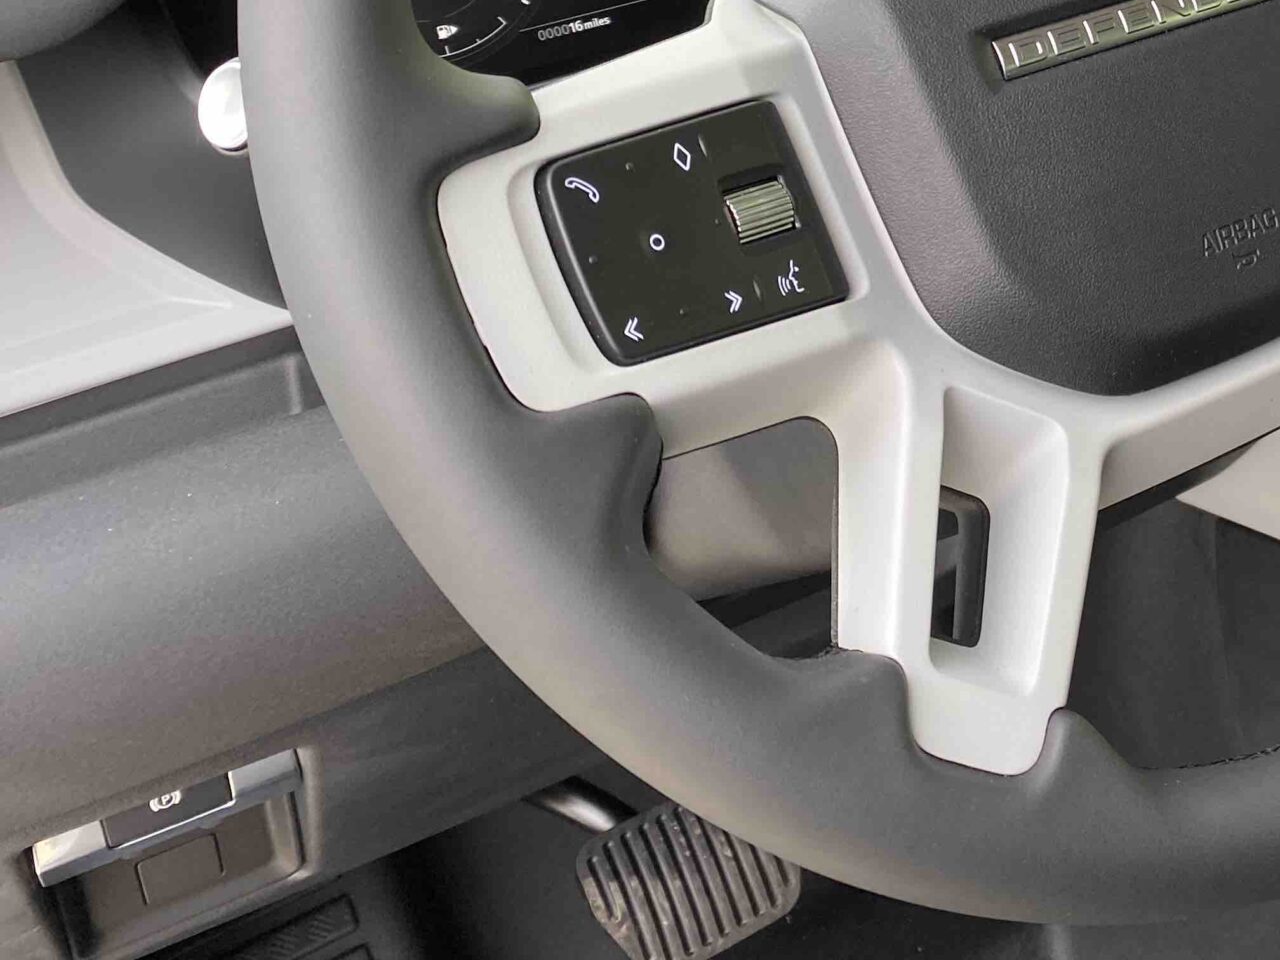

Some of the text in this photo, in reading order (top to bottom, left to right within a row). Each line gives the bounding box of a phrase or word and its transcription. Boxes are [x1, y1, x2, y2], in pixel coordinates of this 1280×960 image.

[537, 16, 612, 41] 000016 miles
[1202, 208, 1279, 257] AIRBAG
